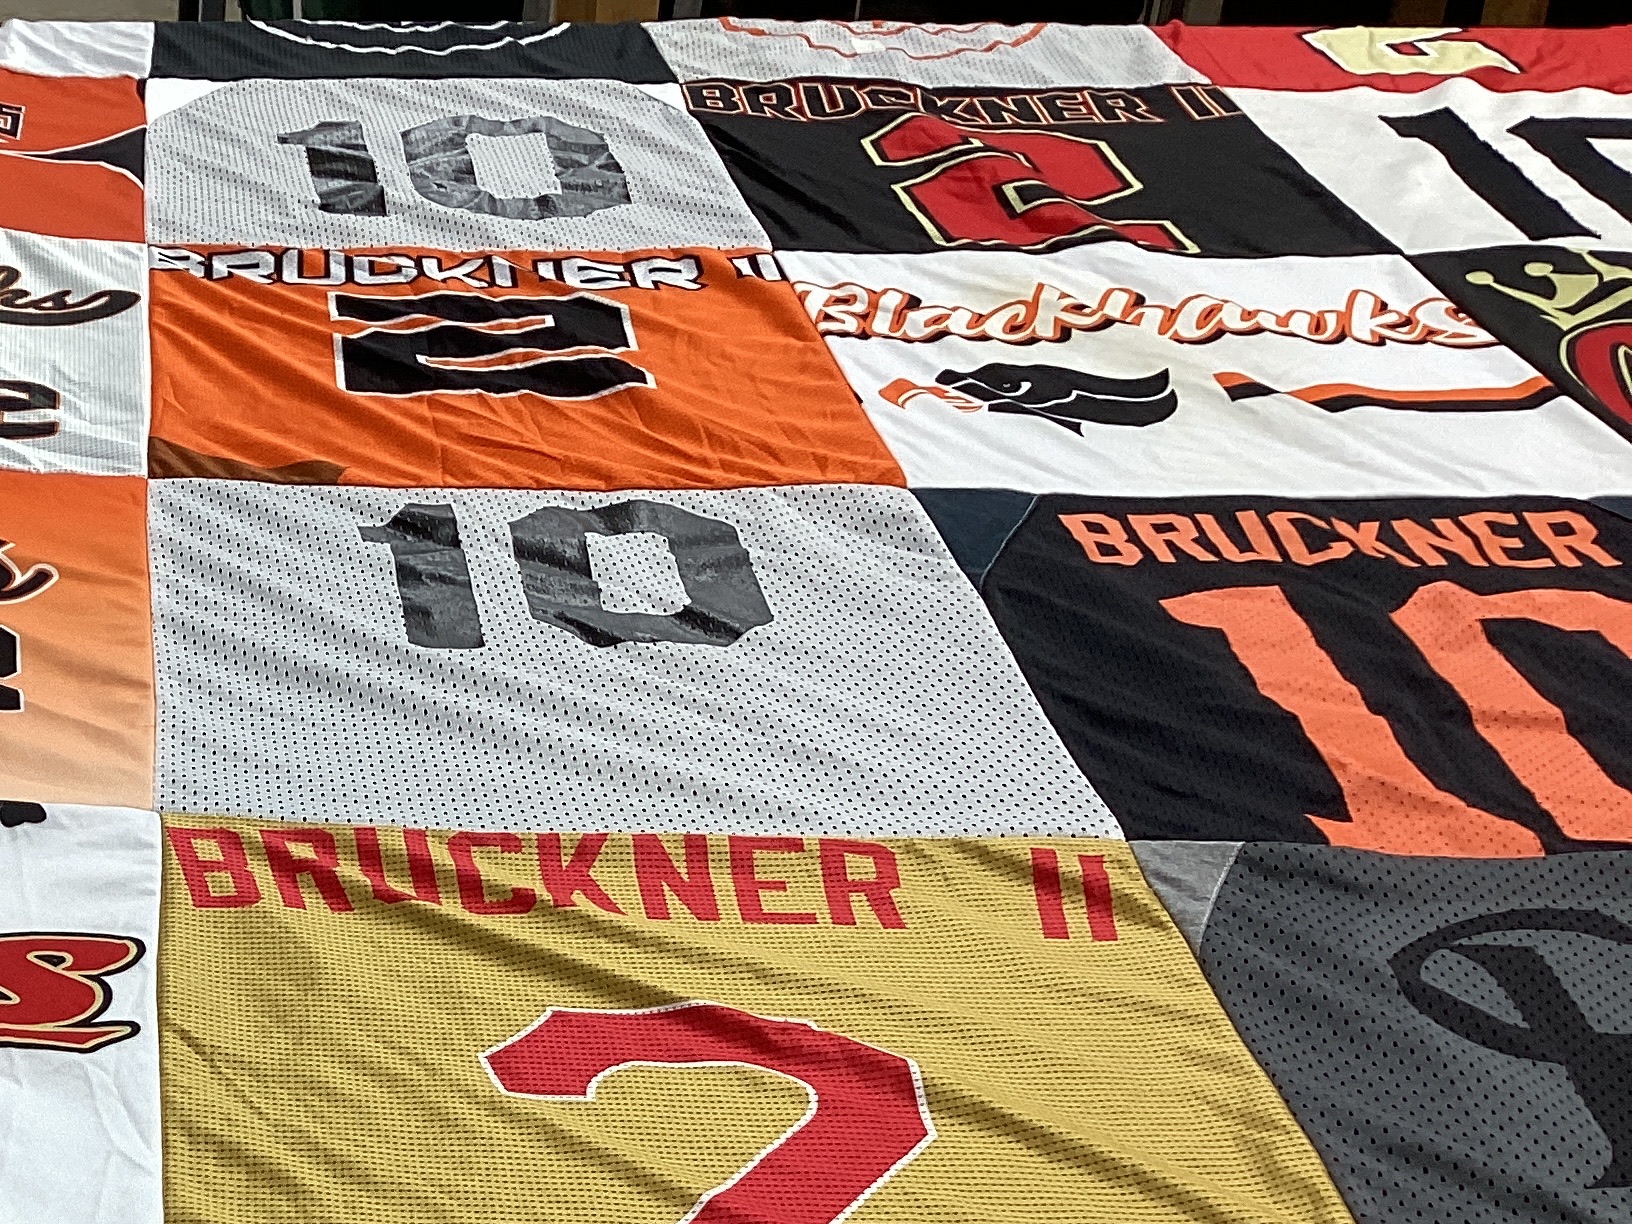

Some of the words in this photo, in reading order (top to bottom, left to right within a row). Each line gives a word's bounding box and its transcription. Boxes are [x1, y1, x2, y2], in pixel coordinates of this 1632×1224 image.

[681, 82, 1165, 123] BRUCKNER
[1171, 86, 1242, 121] II
[276, 113, 632, 221] 10
[861, 112, 1201, 254] 2
[328, 291, 658, 400] 2
[792, 280, 1505, 348] Blackhawks
[356, 498, 774, 650] 10
[1058, 509, 1624, 568] BRUCKNER
[165, 826, 908, 930] BRUCKNER
[1028, 847, 1120, 943] II
